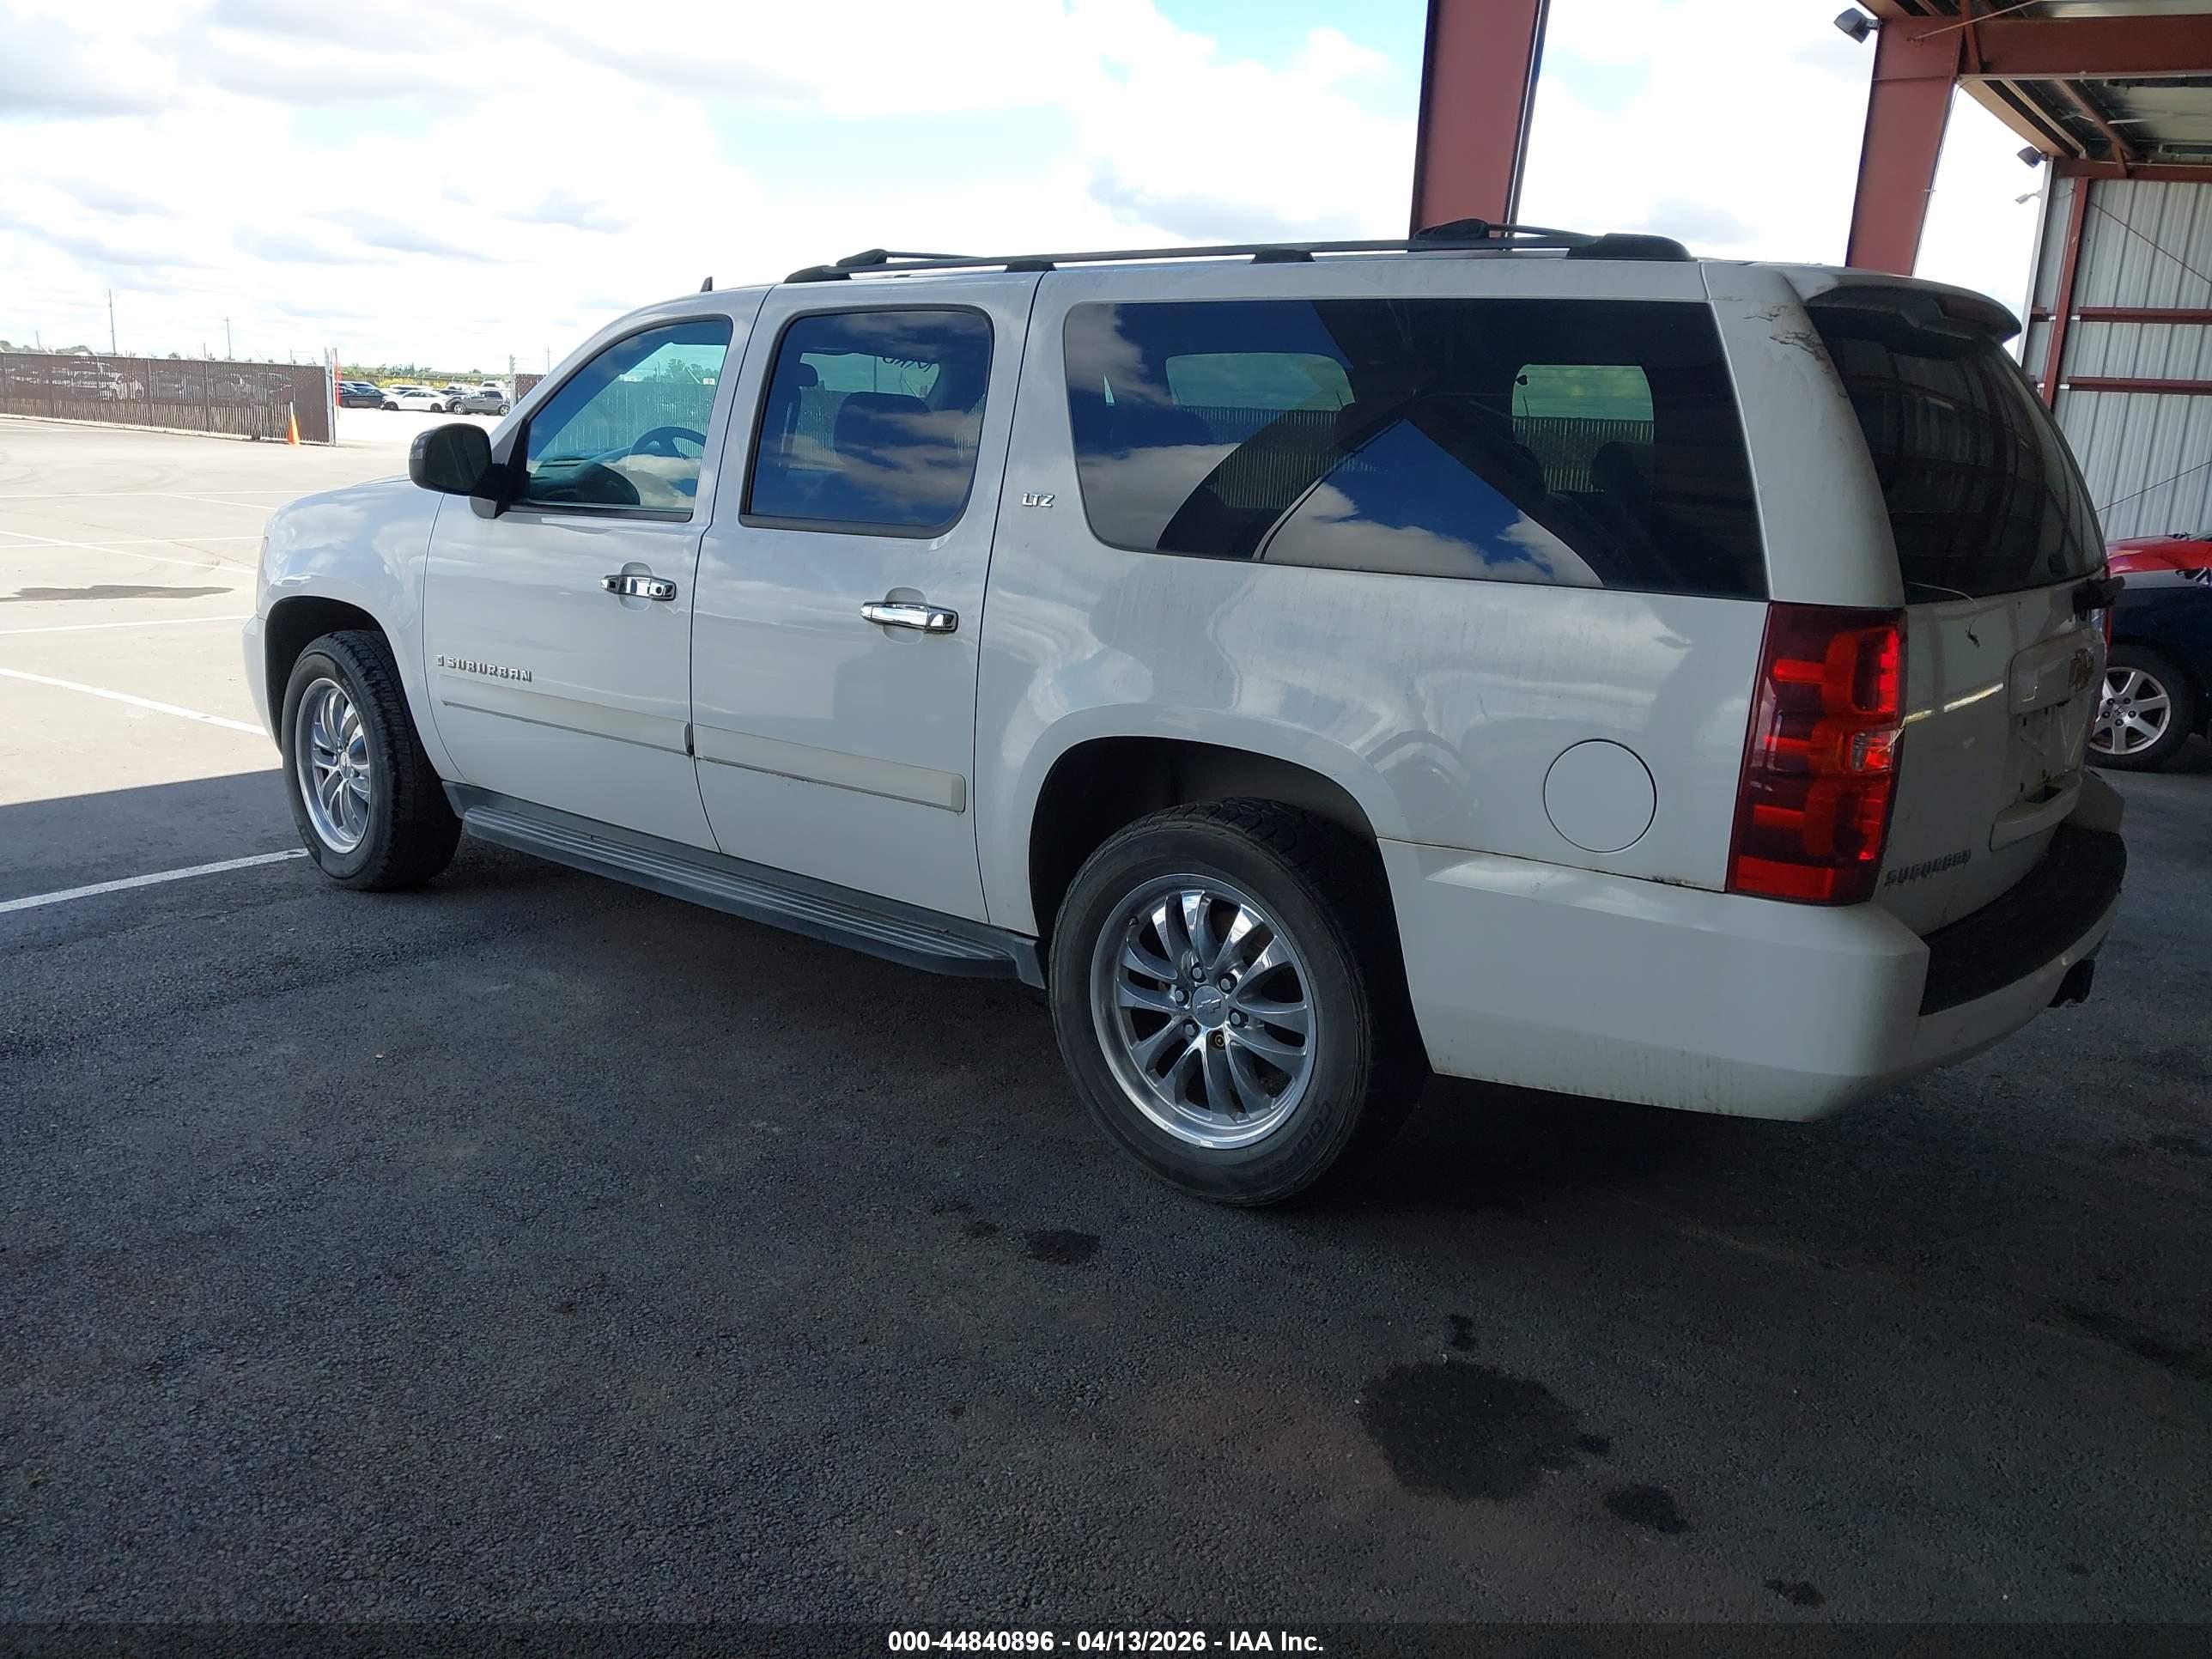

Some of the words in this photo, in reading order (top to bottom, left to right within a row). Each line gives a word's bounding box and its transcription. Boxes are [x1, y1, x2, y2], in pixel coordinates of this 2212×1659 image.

[1022, 493, 1055, 508] LTZ
[447, 657, 532, 683] SUBURBAN
[1884, 848, 1972, 888] SUBURBAN
